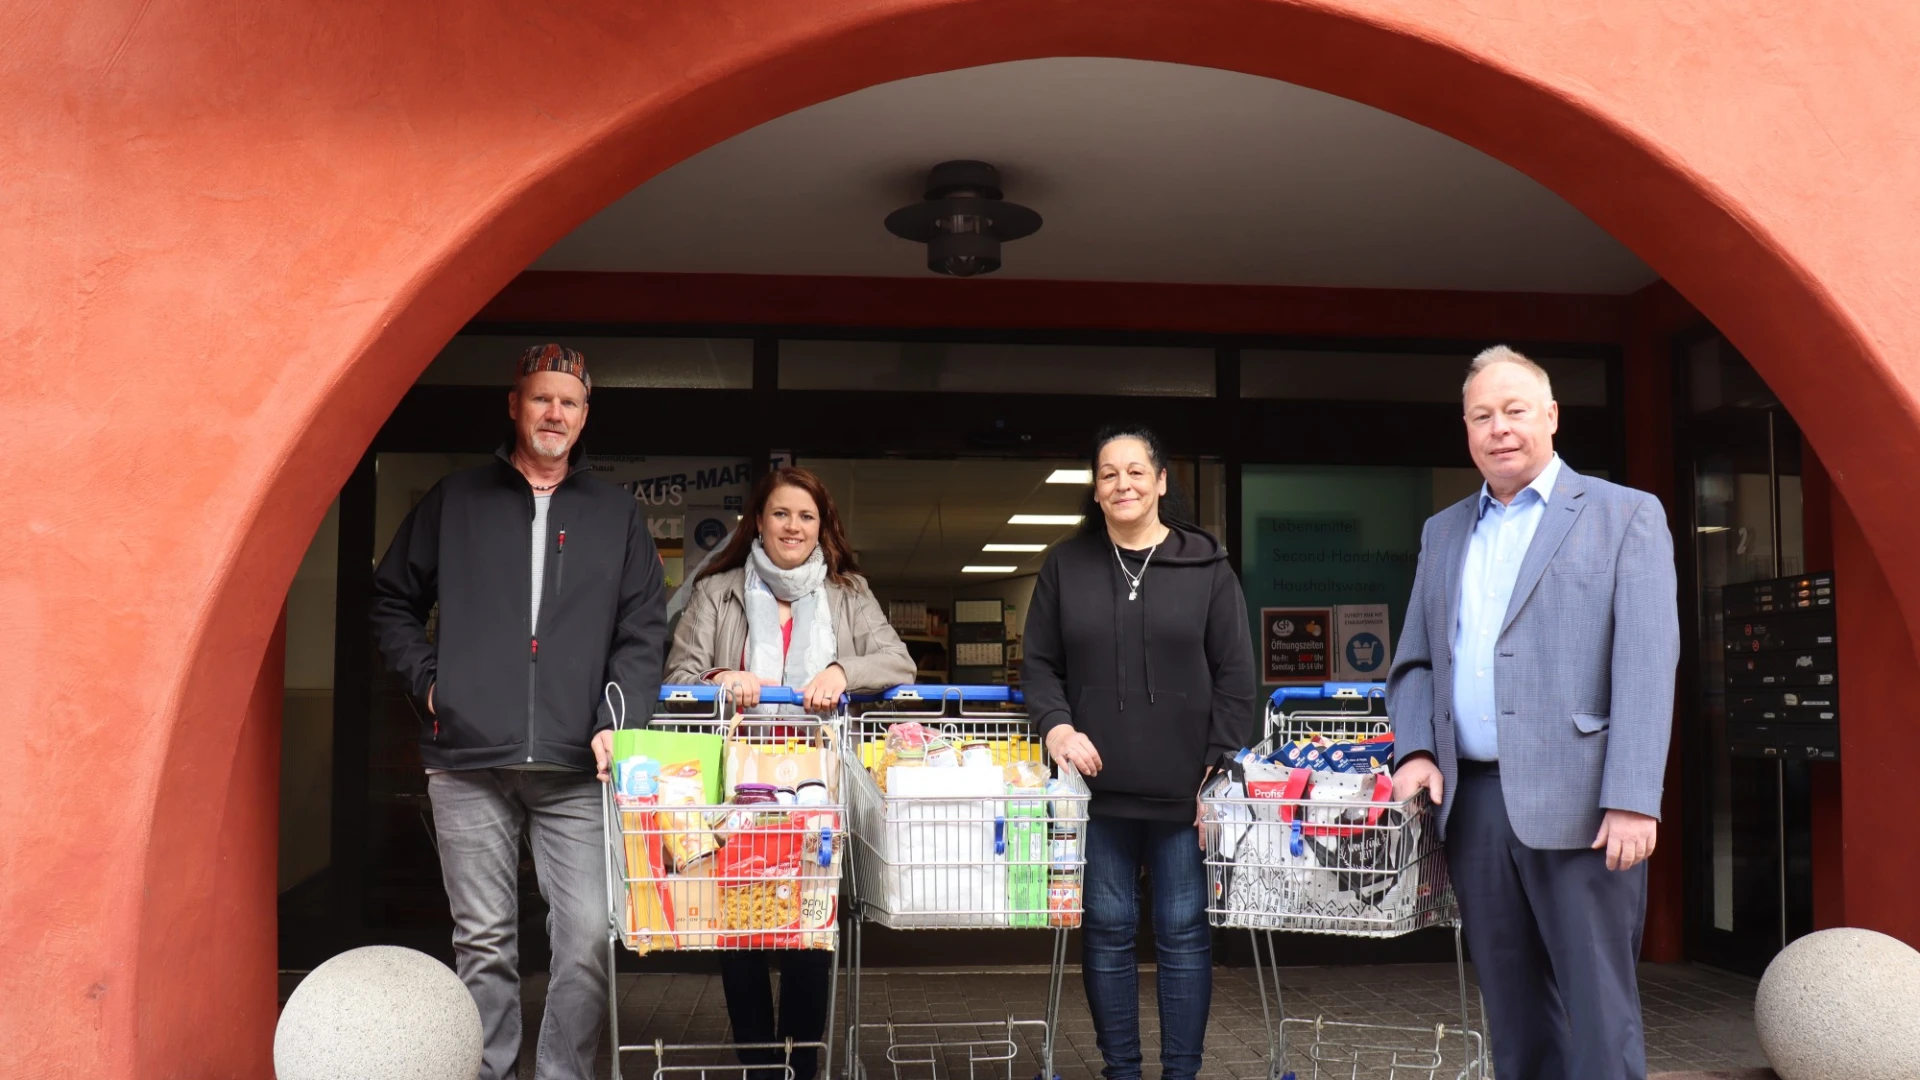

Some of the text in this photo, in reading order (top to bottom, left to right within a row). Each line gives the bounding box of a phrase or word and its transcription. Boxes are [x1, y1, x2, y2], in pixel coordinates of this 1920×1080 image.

[589, 464, 615, 472] haus
[623, 483, 683, 506] AUS
[1272, 519, 1356, 533] Lebensmittel
[1736, 527, 1748, 556] 2
[1273, 577, 1385, 593] Haushaltswaren
[1271, 638, 1324, 652] Öffnungszeiten
